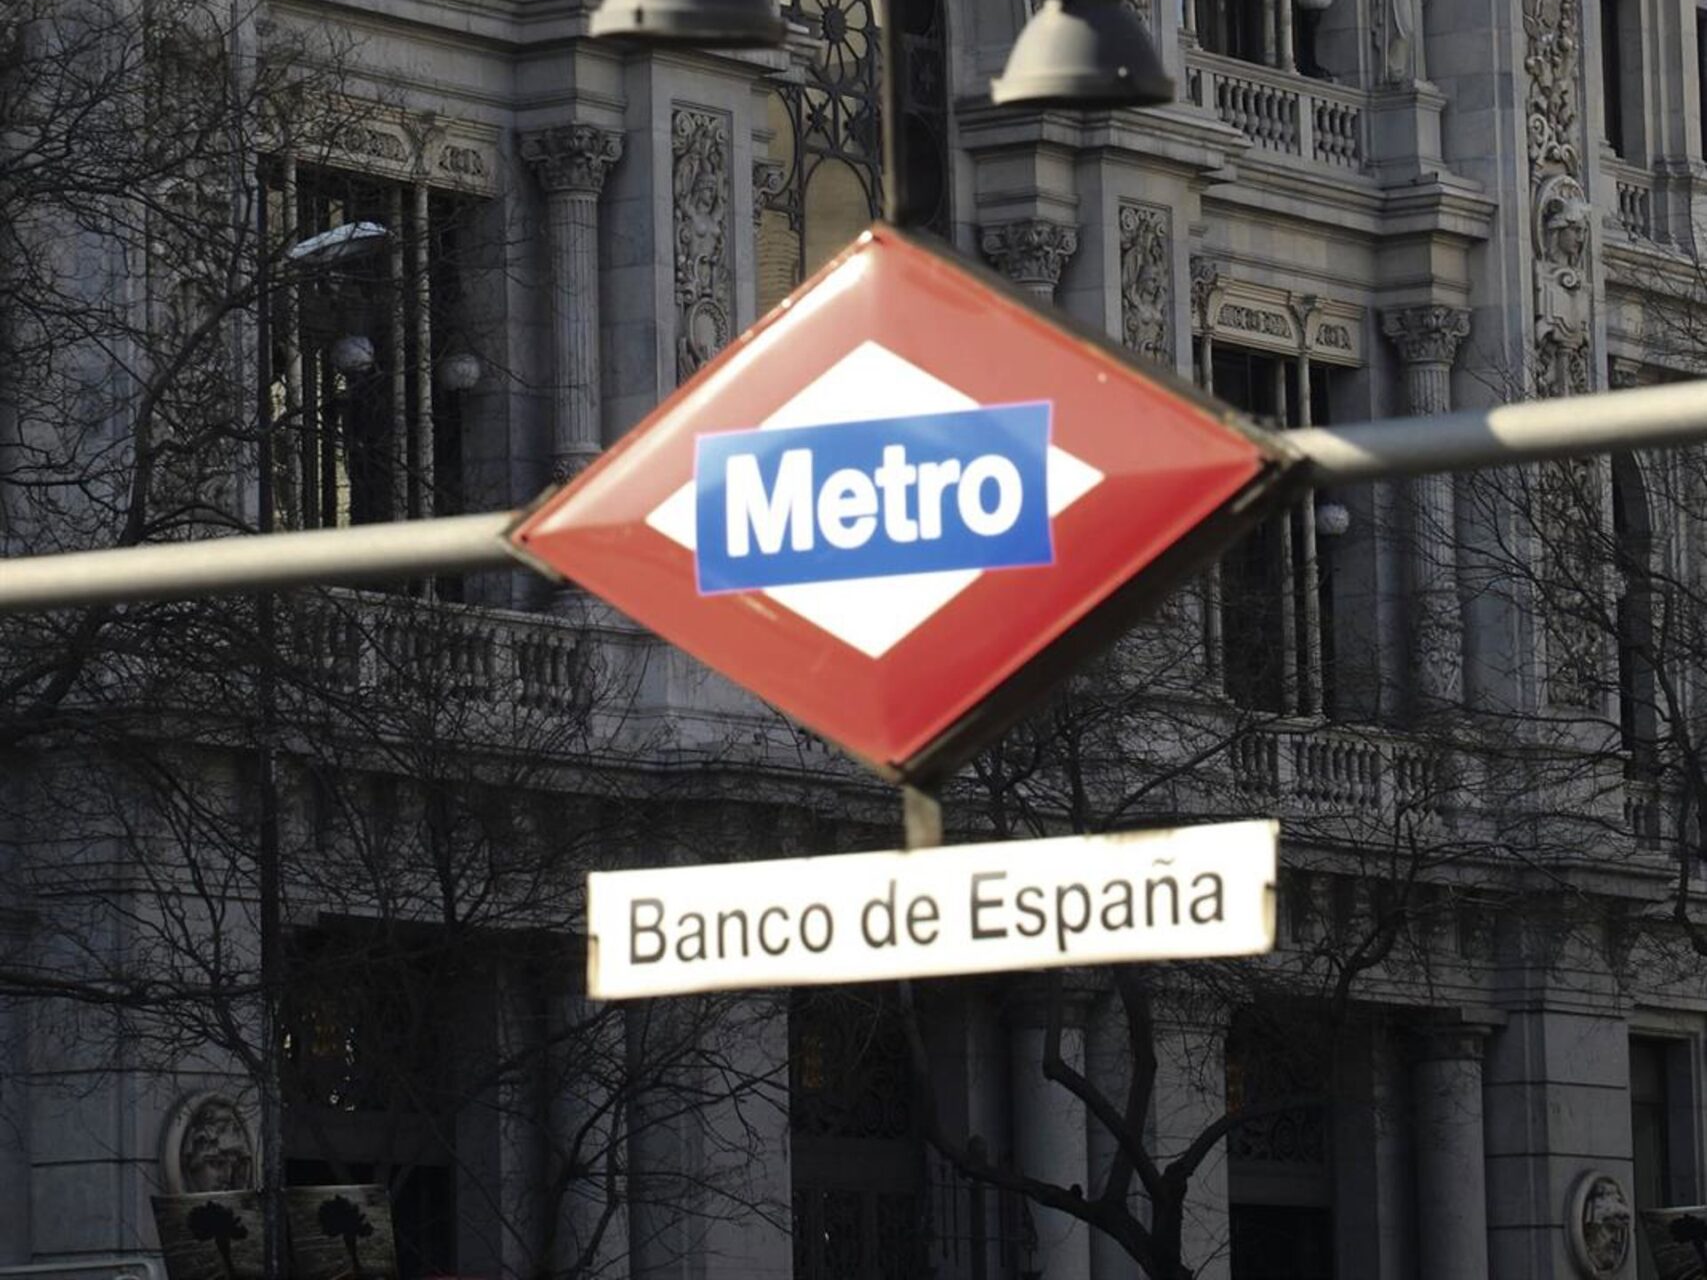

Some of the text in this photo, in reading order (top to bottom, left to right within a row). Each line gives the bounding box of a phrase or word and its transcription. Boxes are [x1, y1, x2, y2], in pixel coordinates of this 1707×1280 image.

[725, 445, 1022, 558] Metro
[628, 857, 1226, 965] Banco de España
